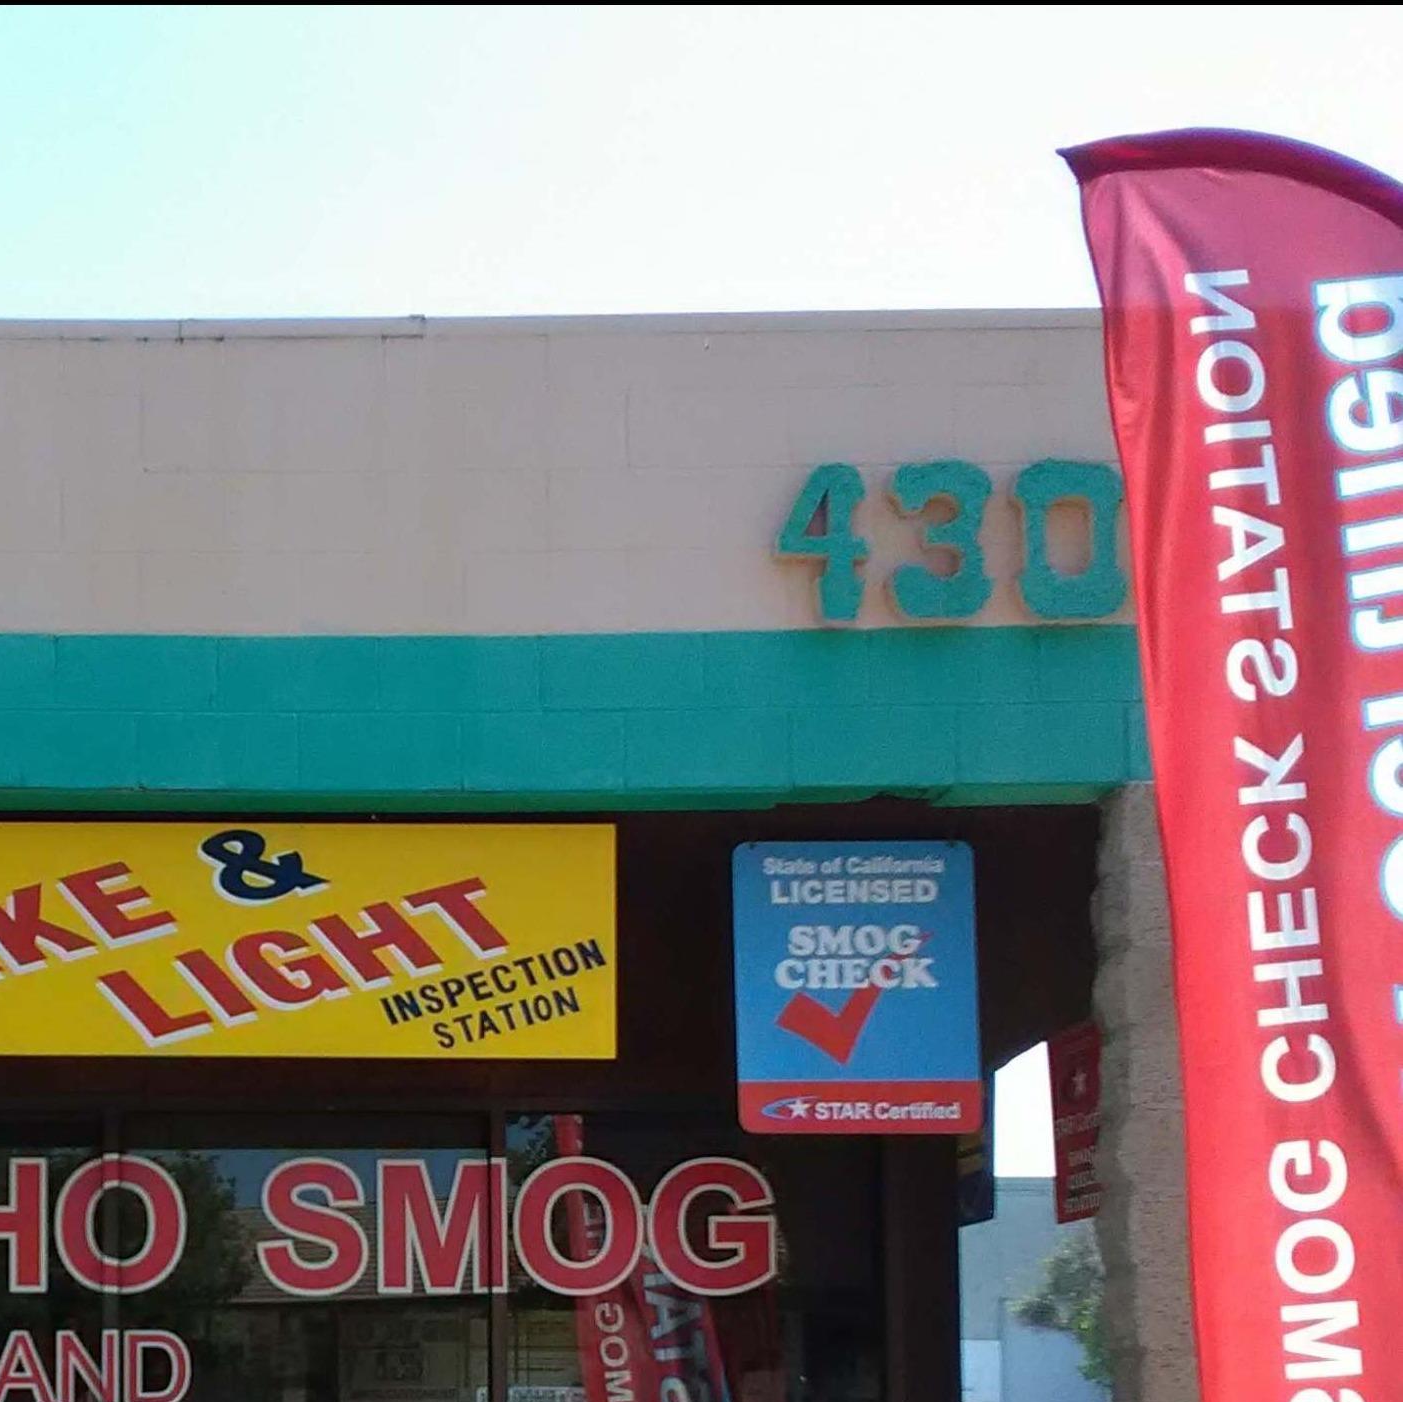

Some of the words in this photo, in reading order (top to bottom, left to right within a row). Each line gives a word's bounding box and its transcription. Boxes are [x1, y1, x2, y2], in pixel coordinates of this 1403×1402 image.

[778, 458, 1128, 622] 430
[198, 829, 331, 905] &
[762, 856, 815, 875] State
[820, 857, 841, 874] of
[847, 855, 945, 875] California
[770, 880, 939, 904] LICENSED
[96, 876, 511, 1048] LIGHT
[788, 924, 921, 956] SMOG
[380, 938, 607, 1026] INSPECTION
[774, 958, 939, 989] CHECK
[432, 986, 580, 1050] STATION
[814, 1101, 873, 1120] STAR
[874, 1101, 961, 1121] Certified
[257, 1156, 778, 1296] SMOG
